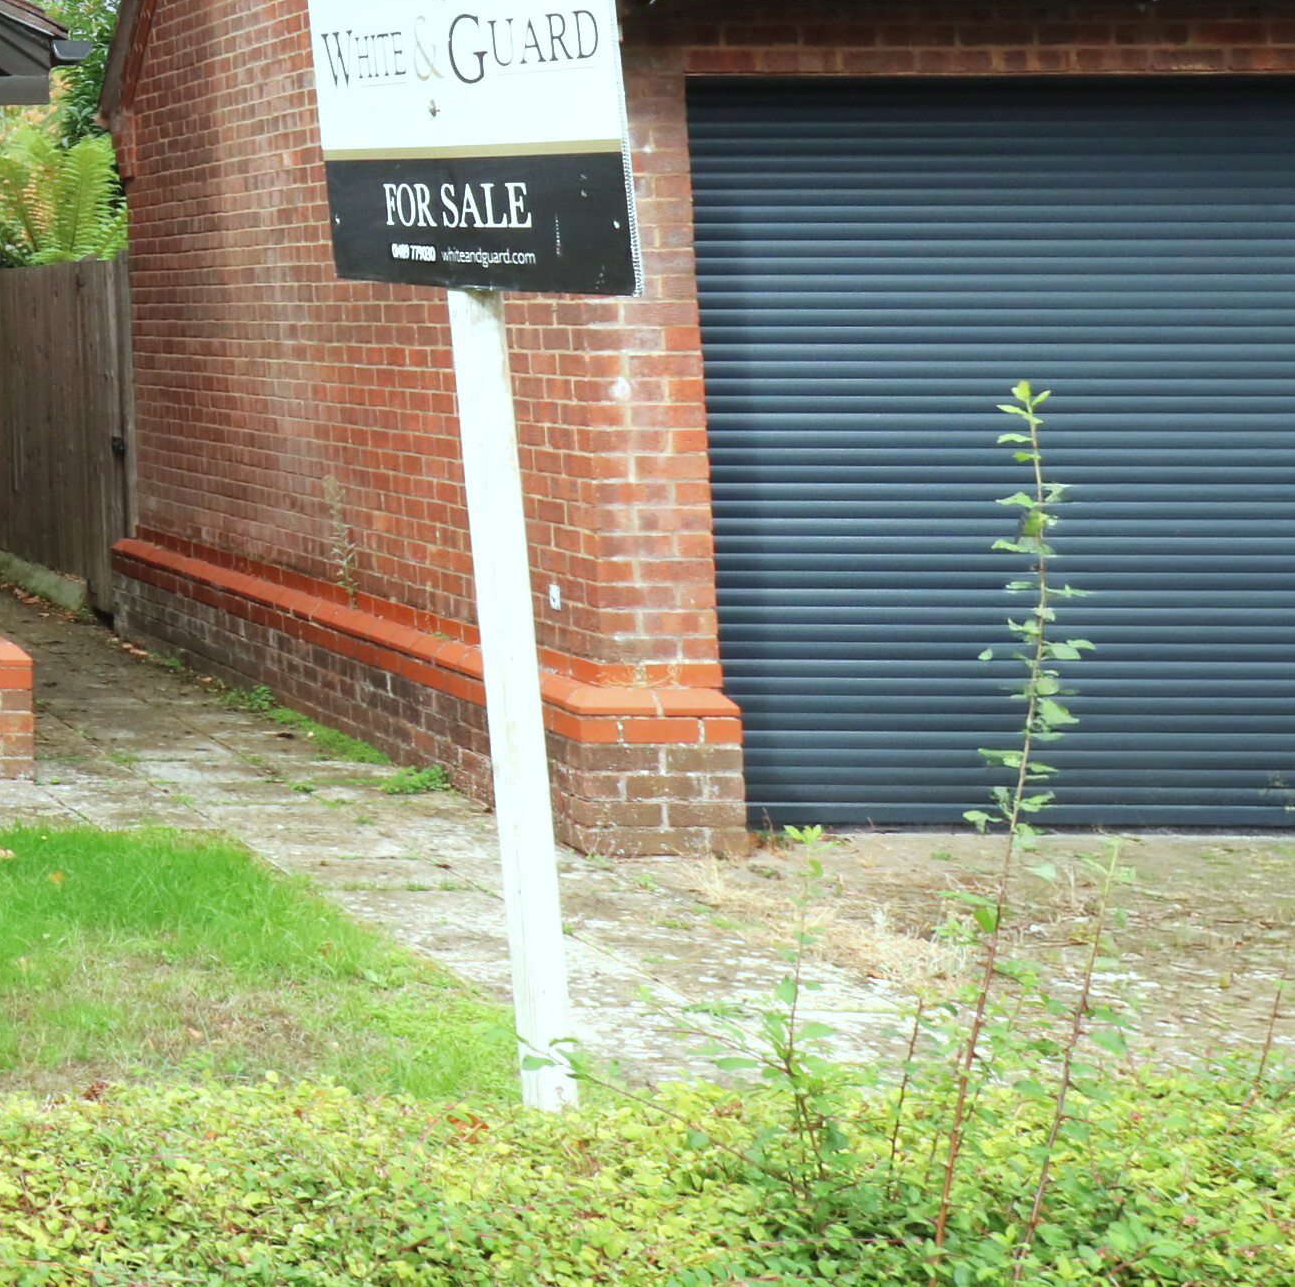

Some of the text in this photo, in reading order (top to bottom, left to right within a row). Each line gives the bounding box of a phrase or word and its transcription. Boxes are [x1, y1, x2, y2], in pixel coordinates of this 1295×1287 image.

[413, 15, 445, 82] &
[383, 182, 532, 229] FOR SALE
[441, 246, 536, 268] whiteandguard.com
